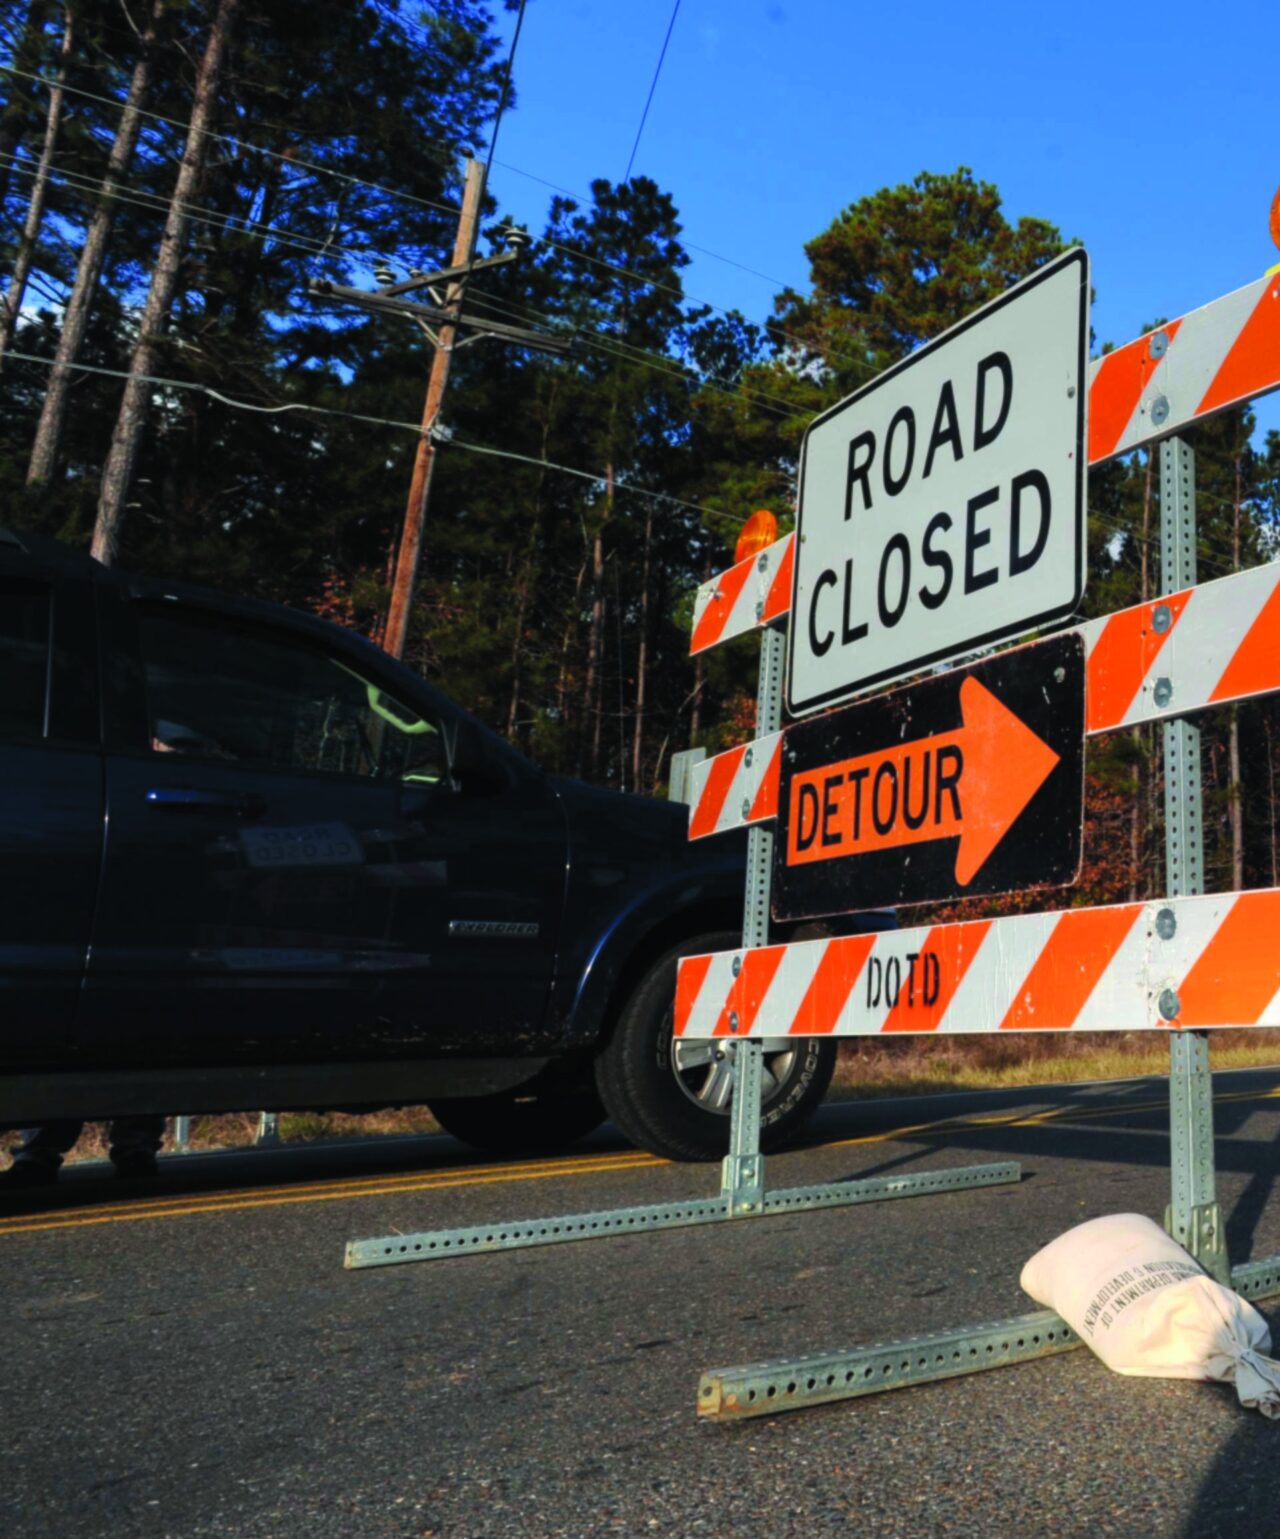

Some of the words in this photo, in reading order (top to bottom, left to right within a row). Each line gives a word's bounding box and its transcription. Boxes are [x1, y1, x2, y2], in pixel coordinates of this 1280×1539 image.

[844, 351, 1013, 522] ROAD
[809, 469, 1052, 657] CLOSED
[796, 744, 964, 852] DETOUR
[867, 952, 940, 1009] DOTD
[1083, 1270, 1134, 1338] DEVELOPMENT
[1100, 1311, 1114, 1330] OF
[1111, 1272, 1173, 1314] DEPARTMENT
